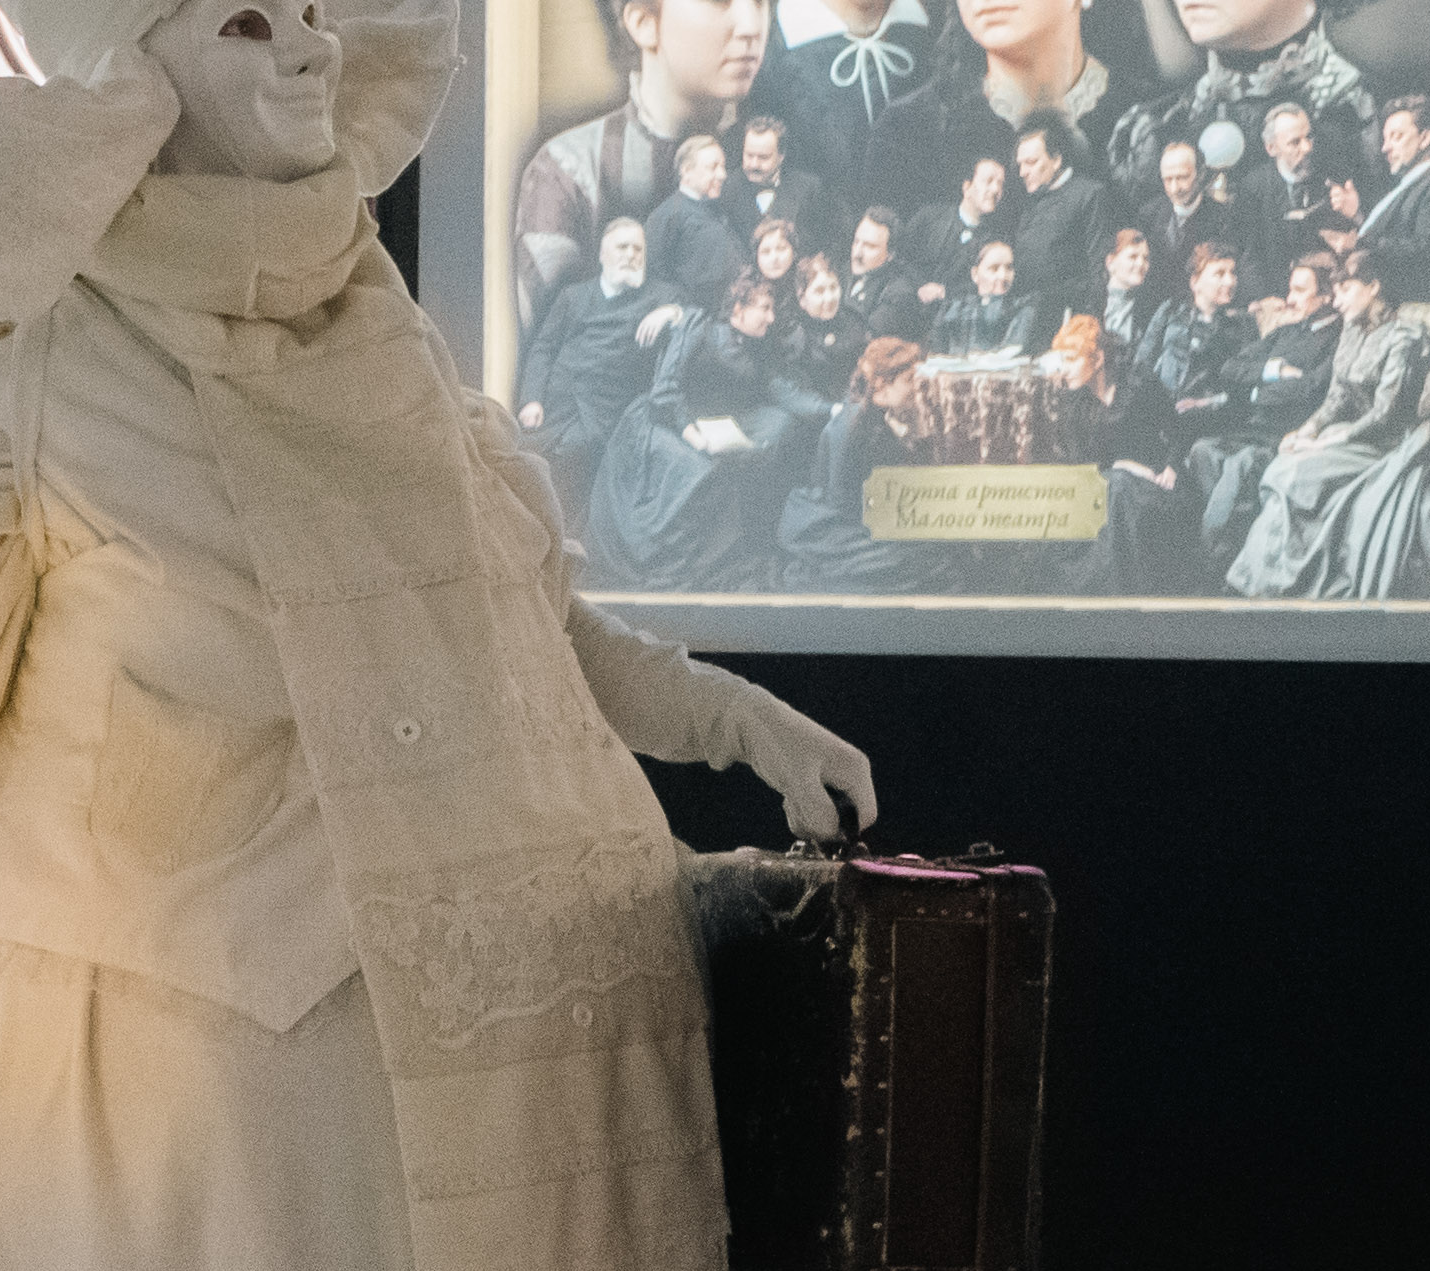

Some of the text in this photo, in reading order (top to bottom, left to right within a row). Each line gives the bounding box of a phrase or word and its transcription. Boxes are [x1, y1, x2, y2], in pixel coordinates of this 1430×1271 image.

[886, 480, 1077, 511] Группа артистов
[896, 505, 1070, 540] Малого театра
